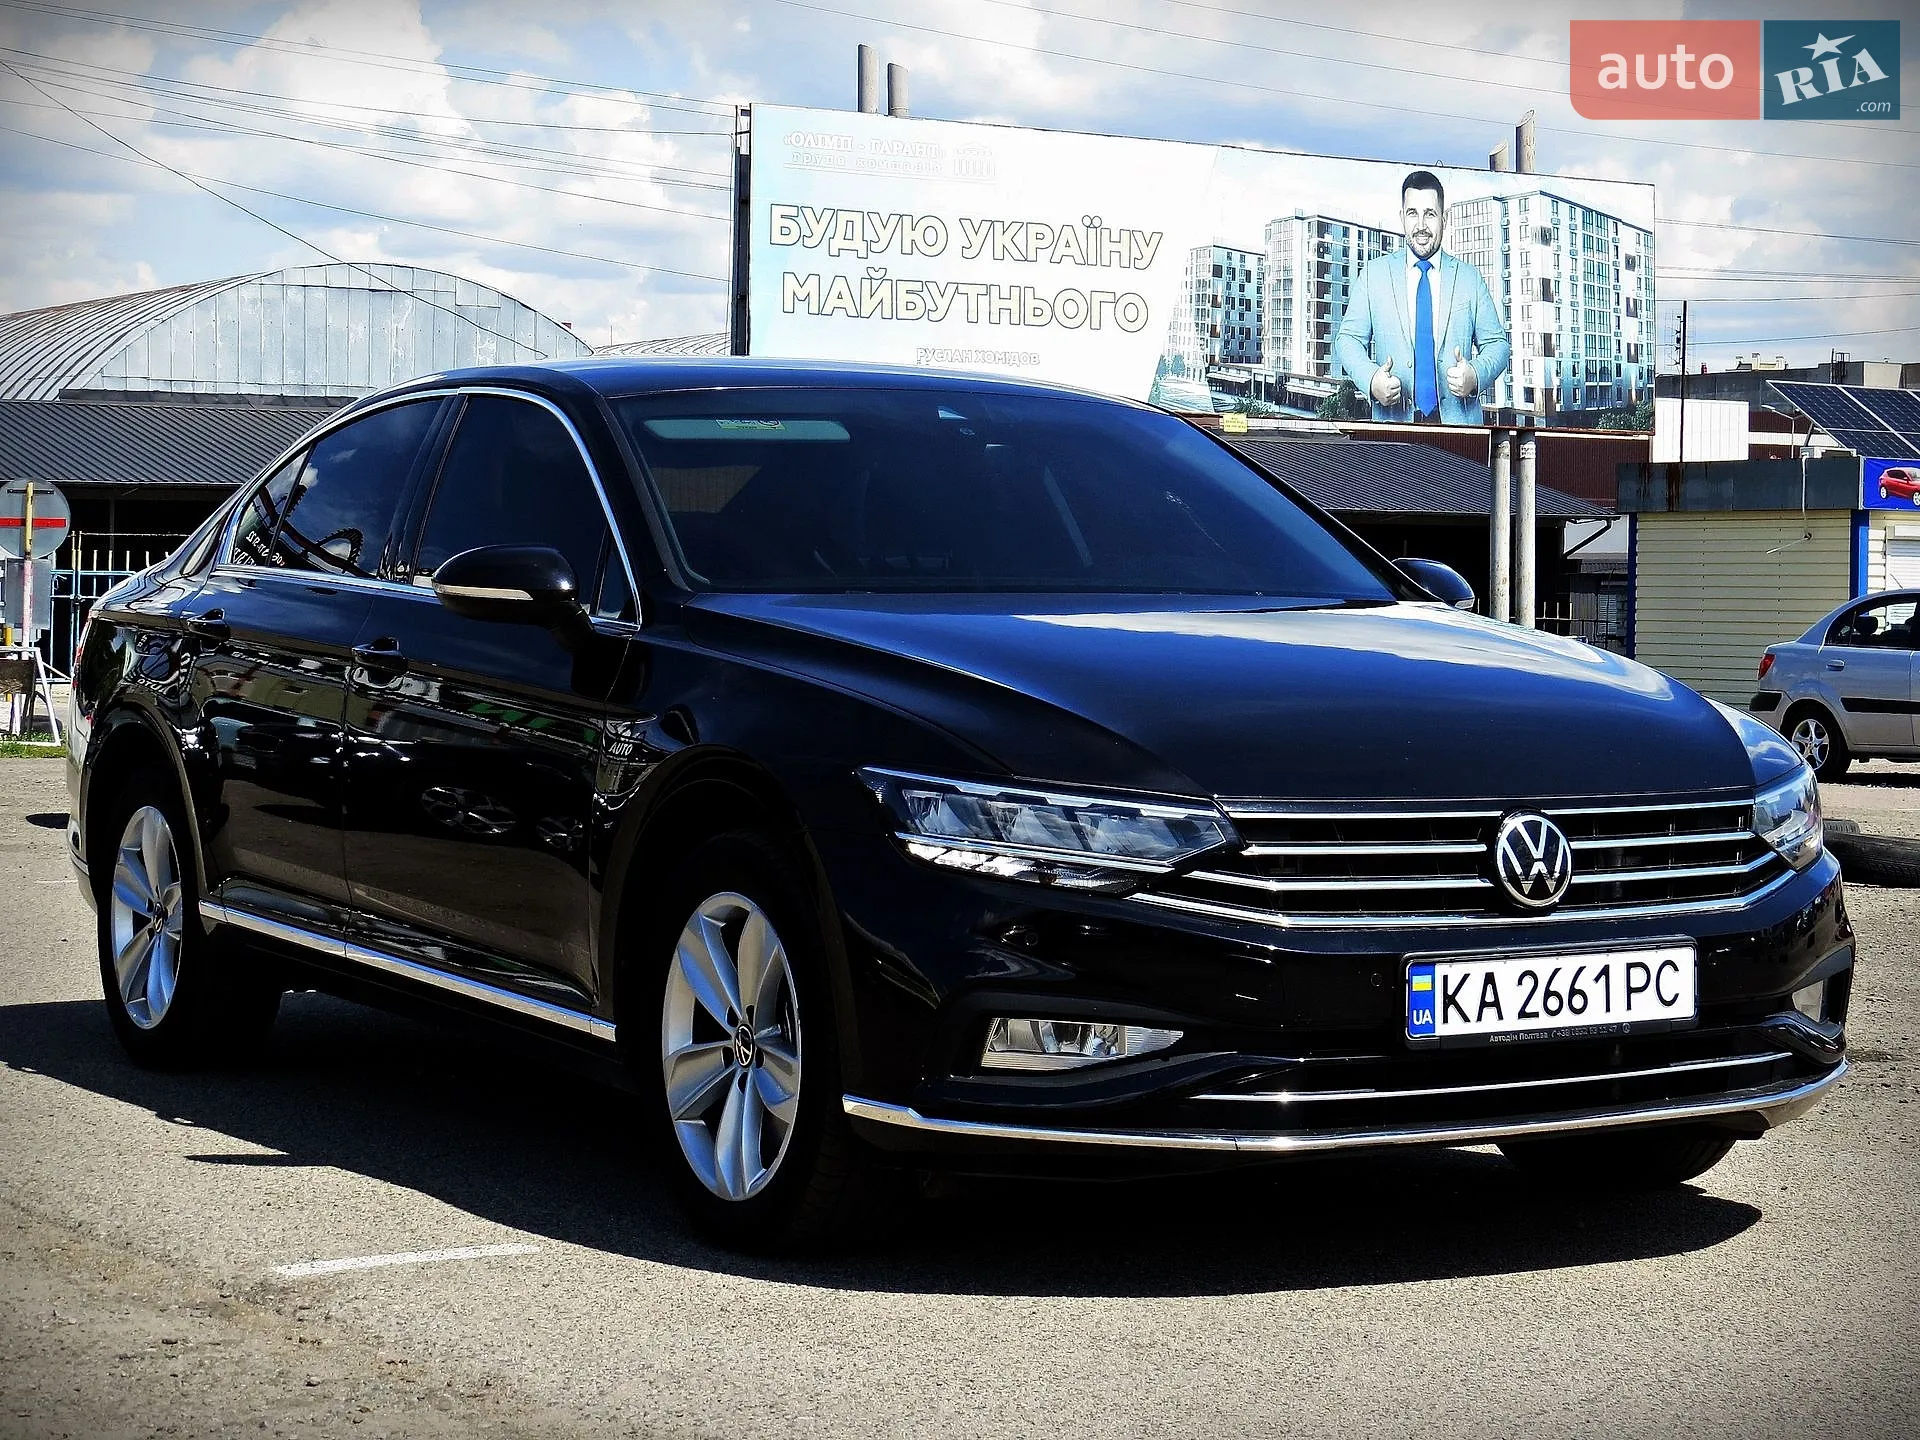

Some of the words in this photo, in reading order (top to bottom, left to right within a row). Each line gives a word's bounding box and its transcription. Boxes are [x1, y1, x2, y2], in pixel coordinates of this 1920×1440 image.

[770, 203, 948, 259] БУДУЮ
[959, 214, 1163, 271] УКРАЇНУ
[782, 267, 1149, 333] МАЙБУТНЬОГО
[916, 347, 973, 364] РУСЛАН
[1413, 1009, 1433, 1025] UA
[1442, 971, 1504, 1024] KA
[1517, 964, 1611, 1019] 2661
[1626, 959, 1680, 1011] PC
